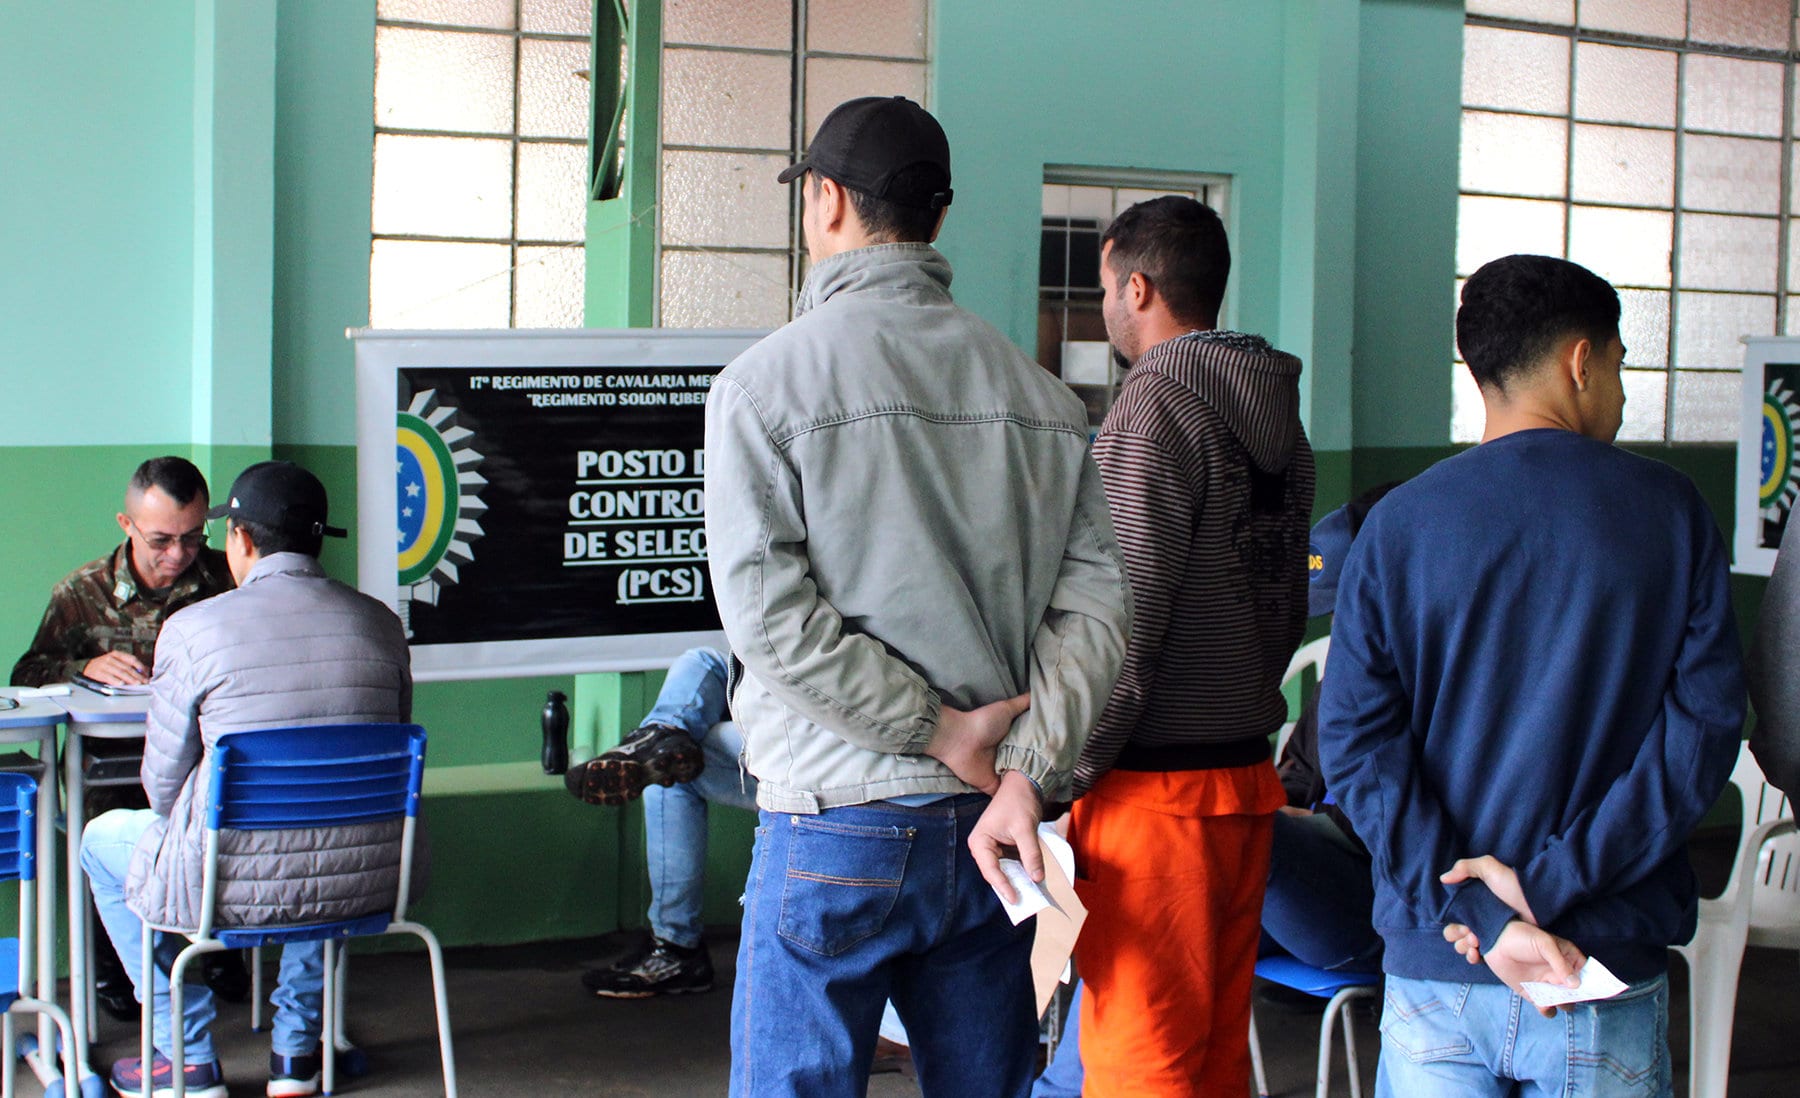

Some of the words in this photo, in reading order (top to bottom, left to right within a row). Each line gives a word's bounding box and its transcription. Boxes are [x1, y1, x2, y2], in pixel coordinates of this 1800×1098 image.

[492, 375, 580, 390] REGIMENTO
[583, 375, 602, 388] DE
[605, 374, 686, 389] CAVALARIA
[618, 392, 667, 405] SOLON
[577, 450, 686, 478] POSTO
[568, 489, 705, 519] CONTRO
[564, 531, 607, 559] DE
[617, 566, 703, 604] (PCS)
